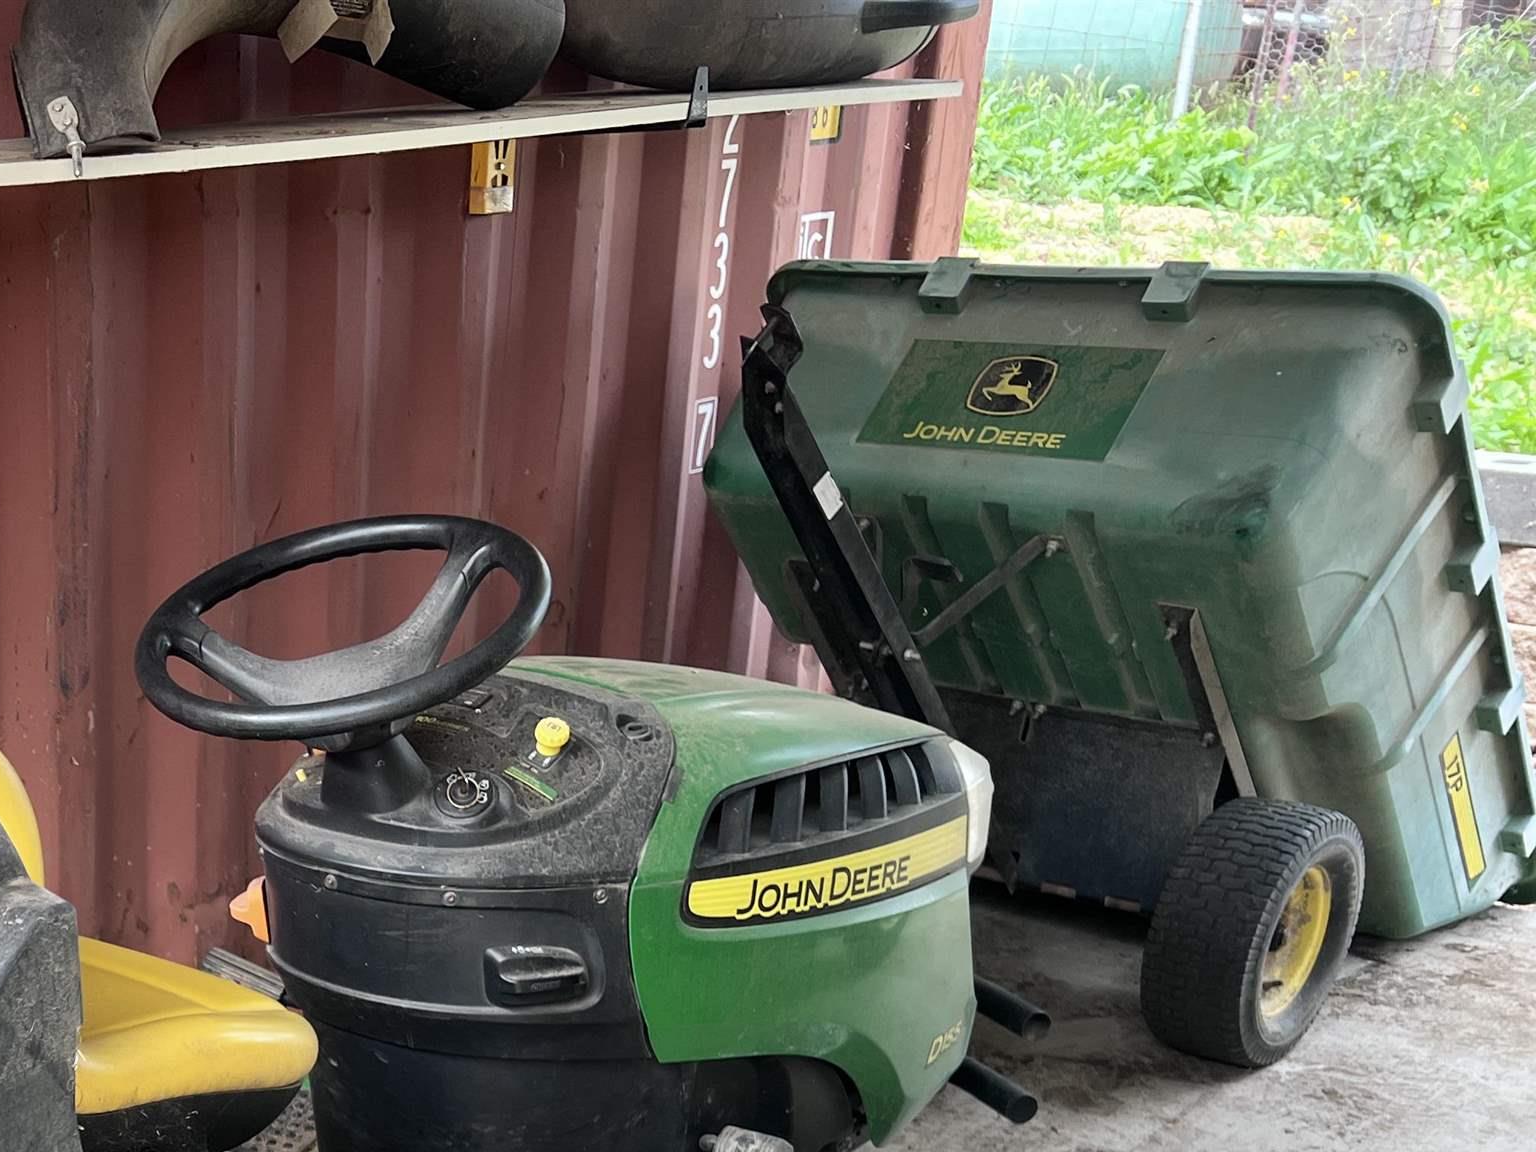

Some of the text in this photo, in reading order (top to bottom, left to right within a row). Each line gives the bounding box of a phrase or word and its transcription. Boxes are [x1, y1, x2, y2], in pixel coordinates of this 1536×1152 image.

[903, 420, 1066, 449] JOHN DEERE
[1446, 754, 1463, 792] 17P
[735, 855, 911, 914] JOHN DEERE
